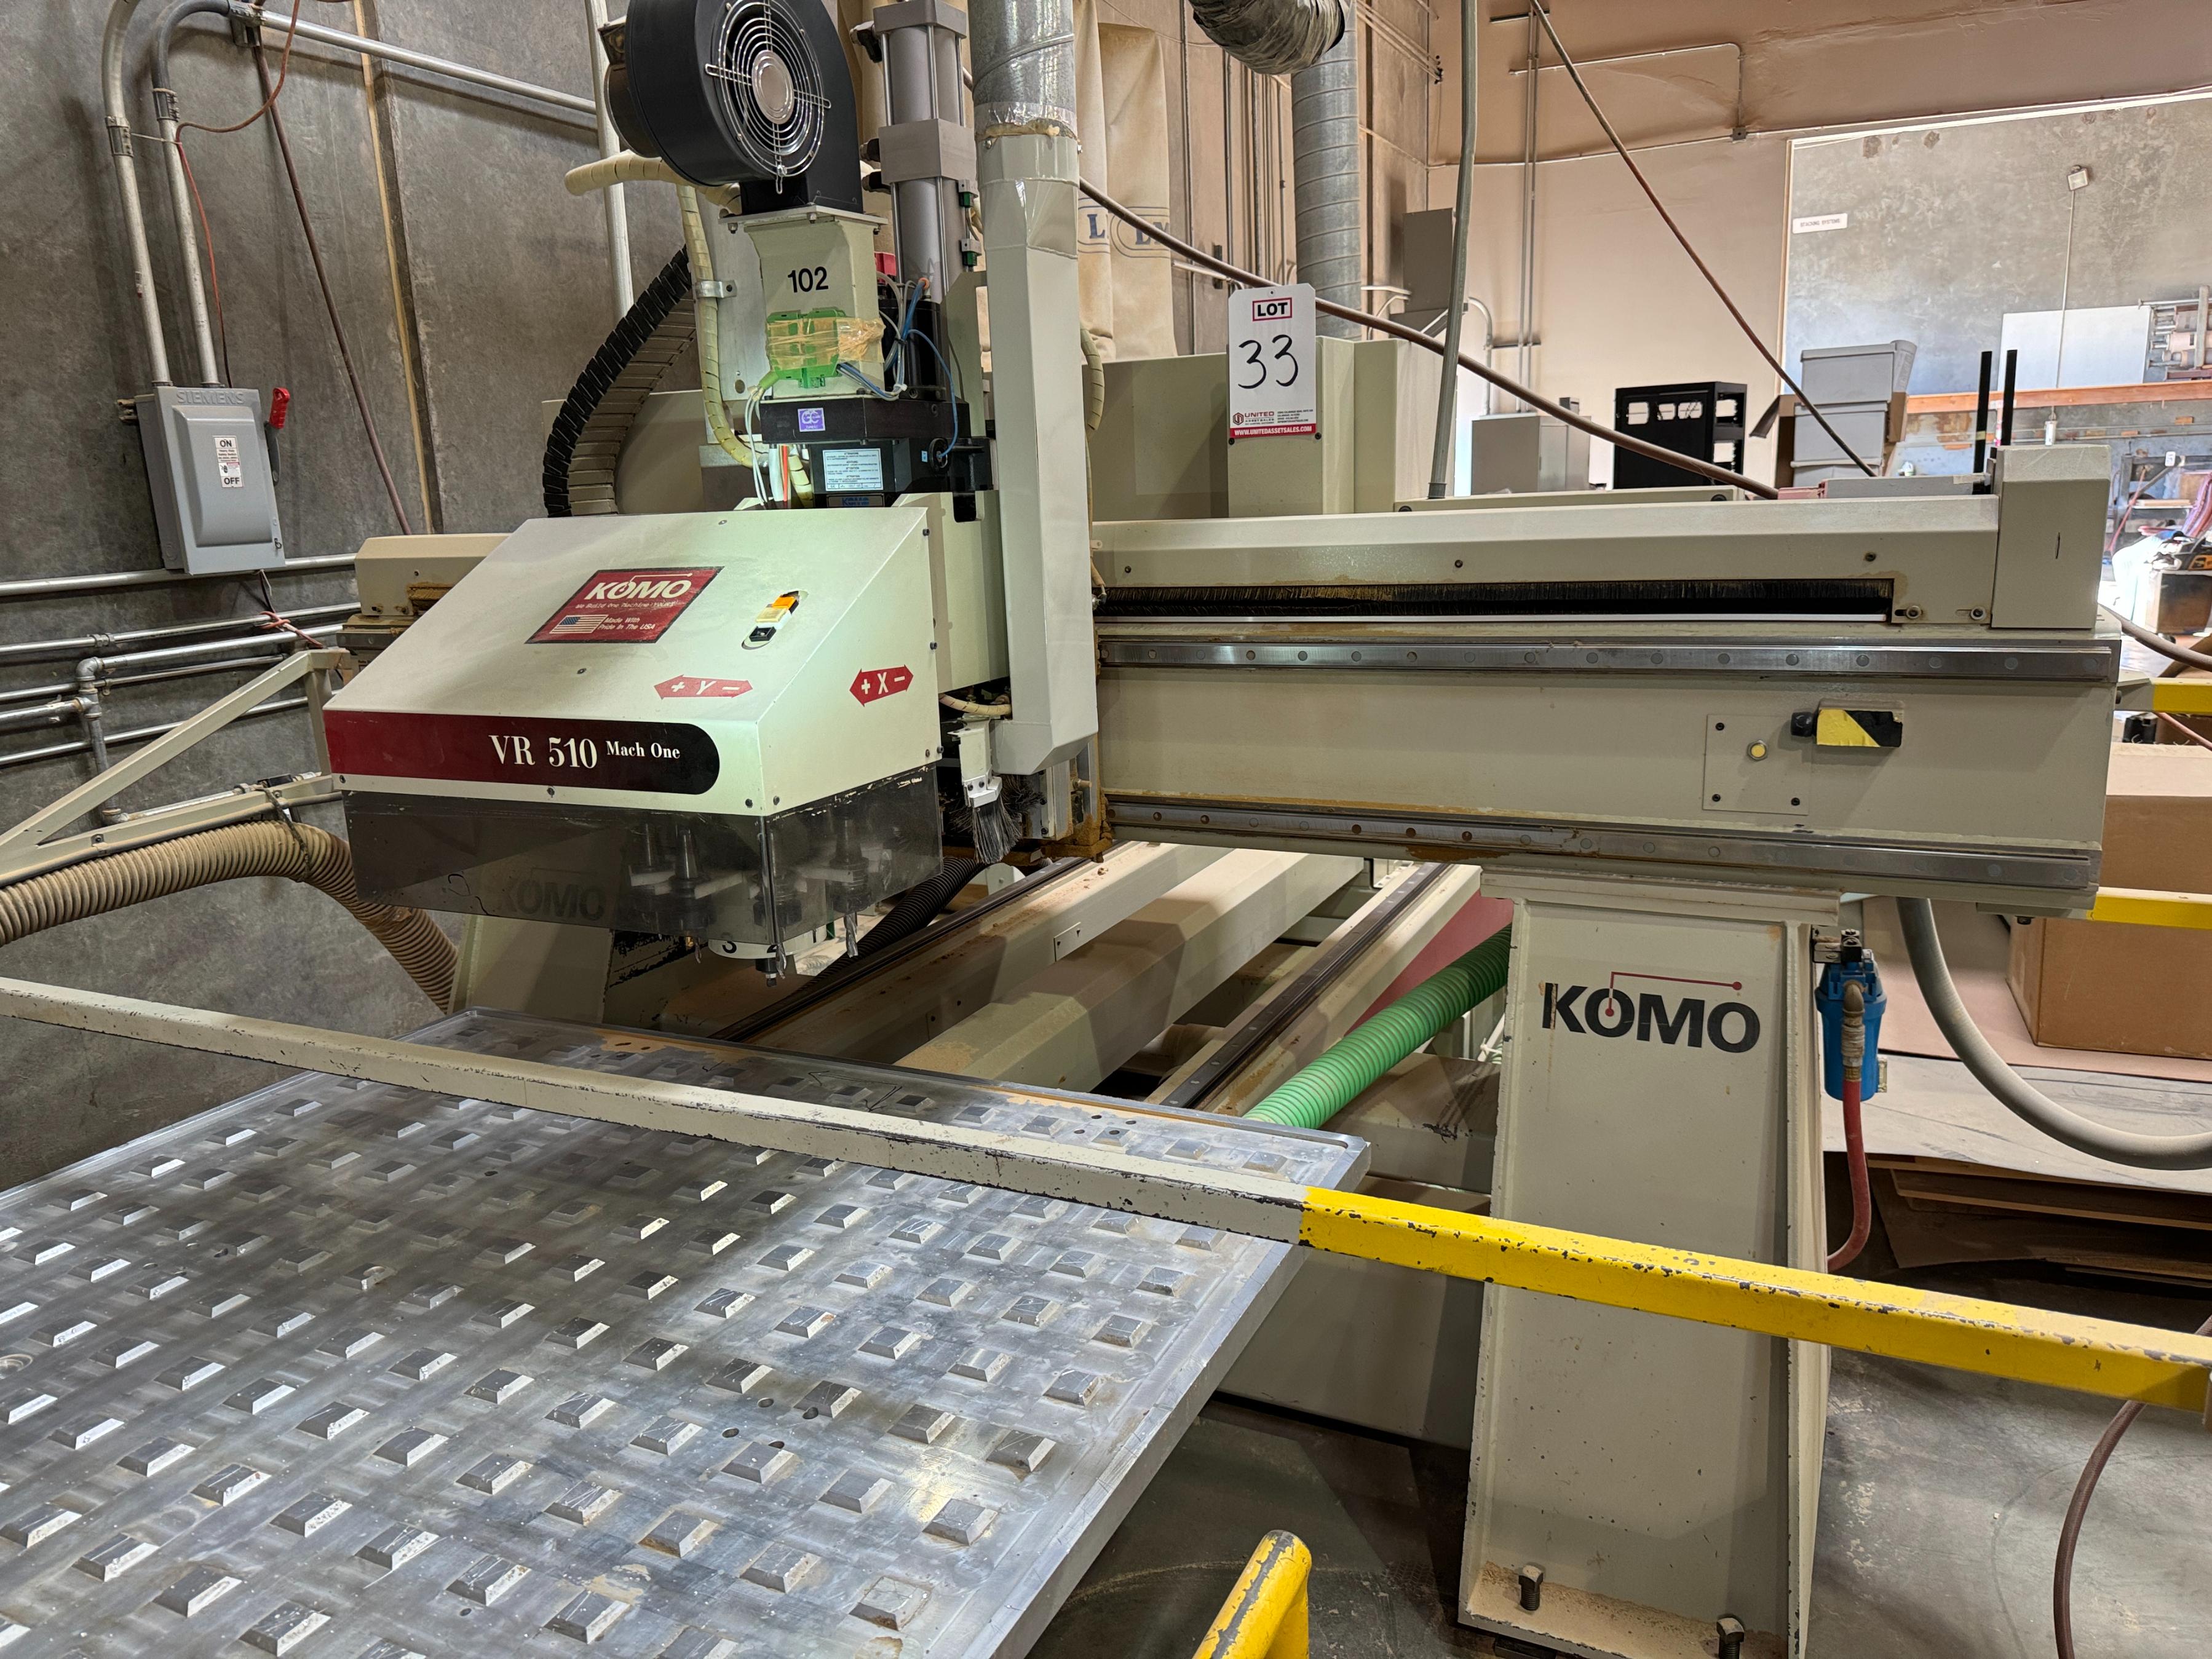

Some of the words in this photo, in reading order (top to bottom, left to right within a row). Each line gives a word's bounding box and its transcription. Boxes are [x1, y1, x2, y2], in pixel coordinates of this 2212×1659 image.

[787, 266, 829, 293] 102
[1257, 302, 1288, 317] LOT
[1238, 334, 1299, 389] 33
[176, 390, 245, 405] SIEMENS
[1234, 426, 1312, 436] WWW.UNITEDASSETSALES.COM
[584, 580, 692, 600] KOMO
[488, 735, 536, 766] VR
[548, 737, 598, 769] 510
[605, 740, 646, 758] Mach
[650, 742, 681, 759] One
[1542, 982, 1761, 1053] KOMO
